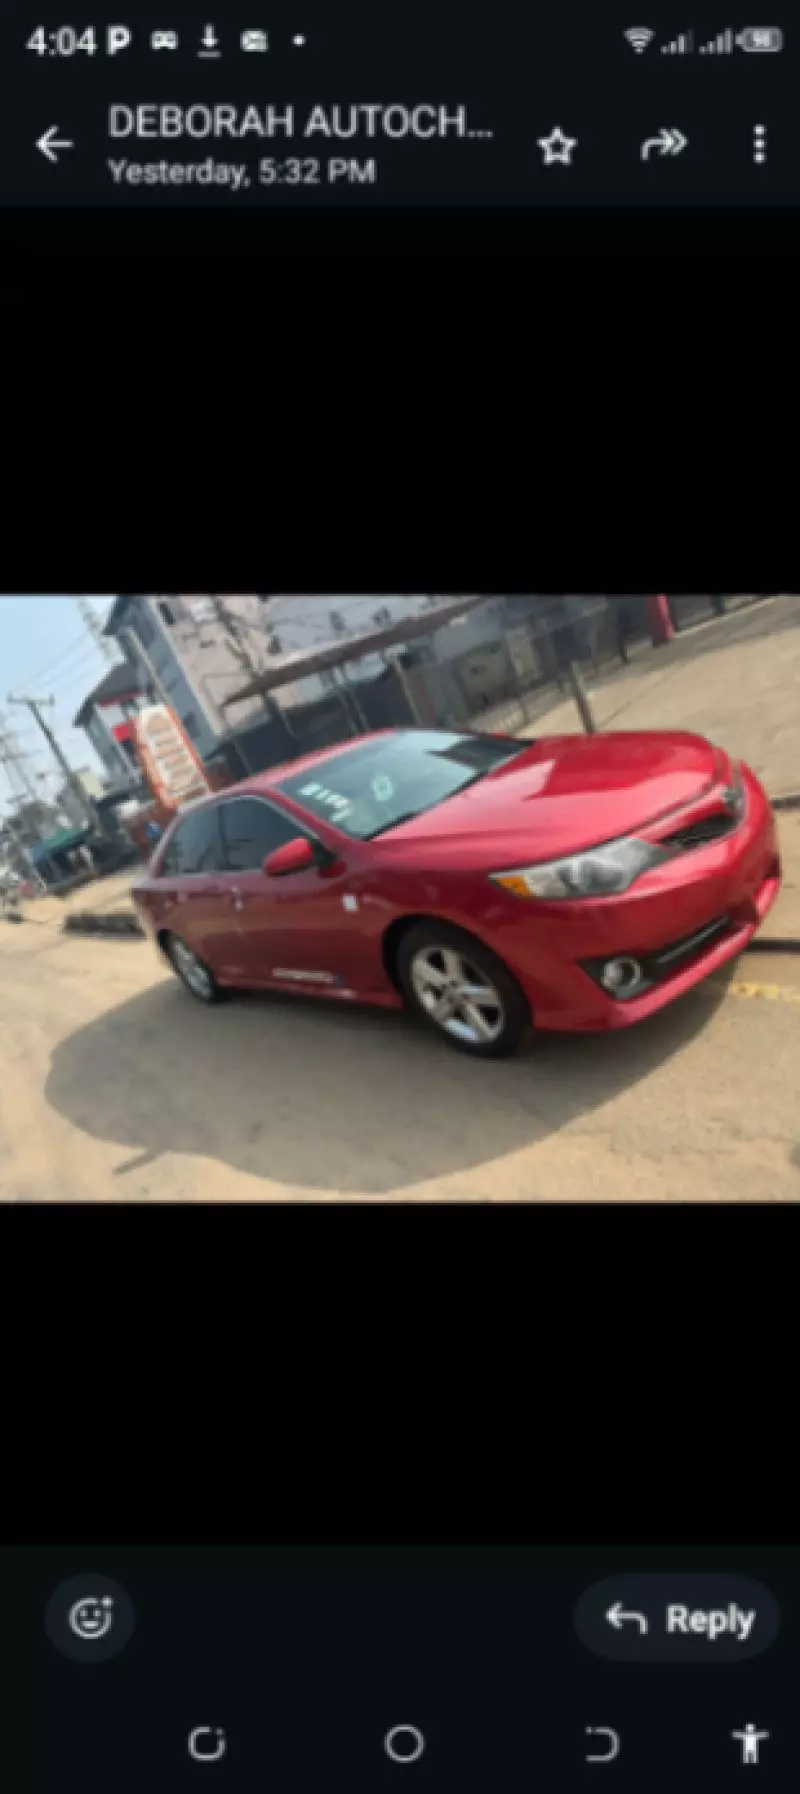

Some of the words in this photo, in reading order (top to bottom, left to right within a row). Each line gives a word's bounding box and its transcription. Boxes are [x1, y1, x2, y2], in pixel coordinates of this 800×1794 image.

[26, 27, 97, 55] 4:04
[110, 105, 293, 137] DEBORAH
[304, 105, 492, 137] AUTOCH...
[109, 158, 250, 188] Yesterday,
[260, 159, 320, 183] 5:32
[328, 159, 375, 183] PM
[666, 1604, 756, 1640] Reply
